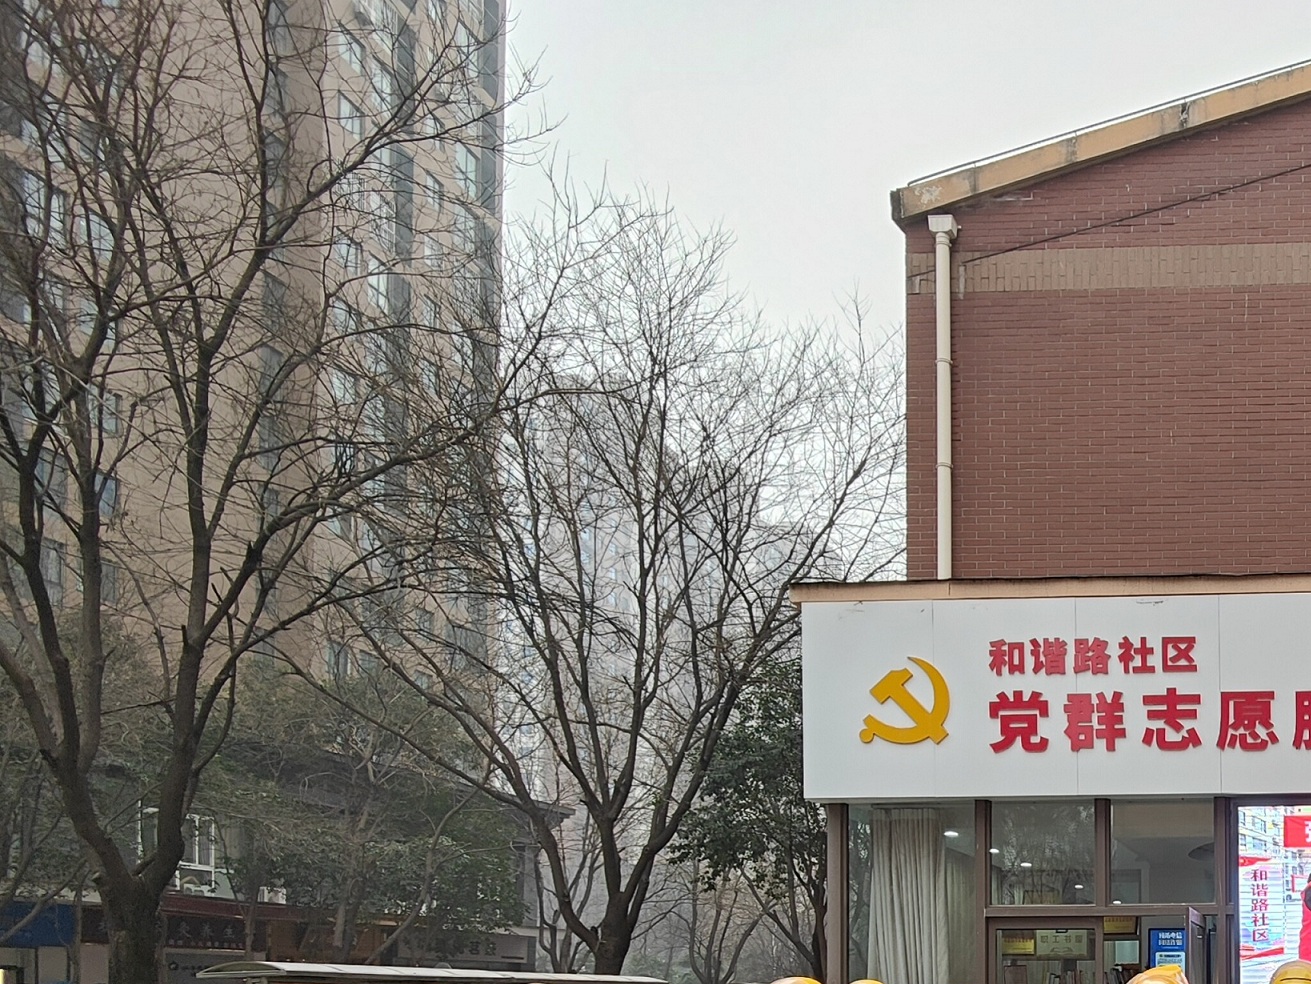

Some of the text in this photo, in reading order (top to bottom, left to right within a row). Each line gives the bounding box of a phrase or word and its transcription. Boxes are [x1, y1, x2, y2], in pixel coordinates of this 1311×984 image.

[988, 635, 1198, 677] 和谐路社区
[1250, 868, 1270, 943] 和谐路社区
